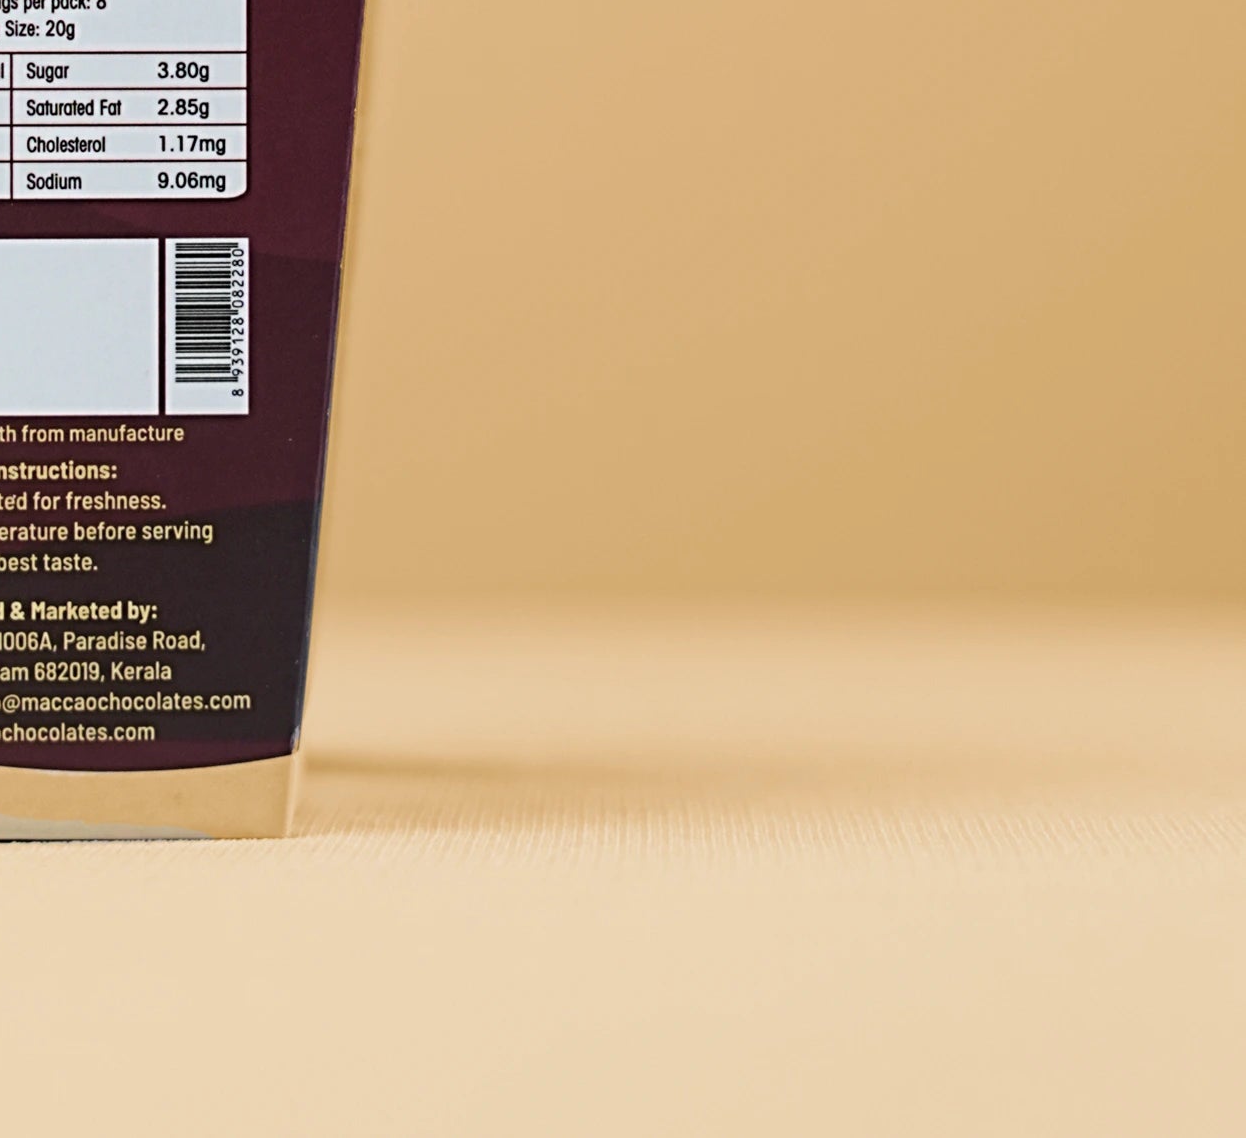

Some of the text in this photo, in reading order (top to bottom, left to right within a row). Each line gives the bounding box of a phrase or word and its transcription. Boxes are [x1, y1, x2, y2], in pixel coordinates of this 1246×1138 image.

[4, 19, 40, 38] Size:
[45, 19, 76, 41] 20g
[26, 61, 70, 84] Sugar
[157, 61, 210, 83] 3.80g
[26, 98, 122, 117] Saturated Fat
[157, 98, 210, 120] 2.85g
[26, 135, 106, 154] Cholesterol
[159, 134, 226, 156] 1.17mg
[26, 172, 82, 191] Sodium
[157, 171, 226, 193] 9.06mg
[21, 424, 65, 443] from
[69, 424, 185, 442] manufacture
[32, 491, 61, 511] for
[65, 490, 167, 510] freshness.
[73, 521, 137, 541] before
[142, 520, 213, 544] serving
[42, 553, 98, 572] taste.
[9, 601, 26, 621] &
[30, 600, 123, 621] Marketed
[127, 600, 158, 625] by:
[63, 630, 148, 651] Paradise
[152, 630, 206, 651] Road,
[34, 661, 105, 683] 682019,
[111, 660, 172, 681] Kerala
